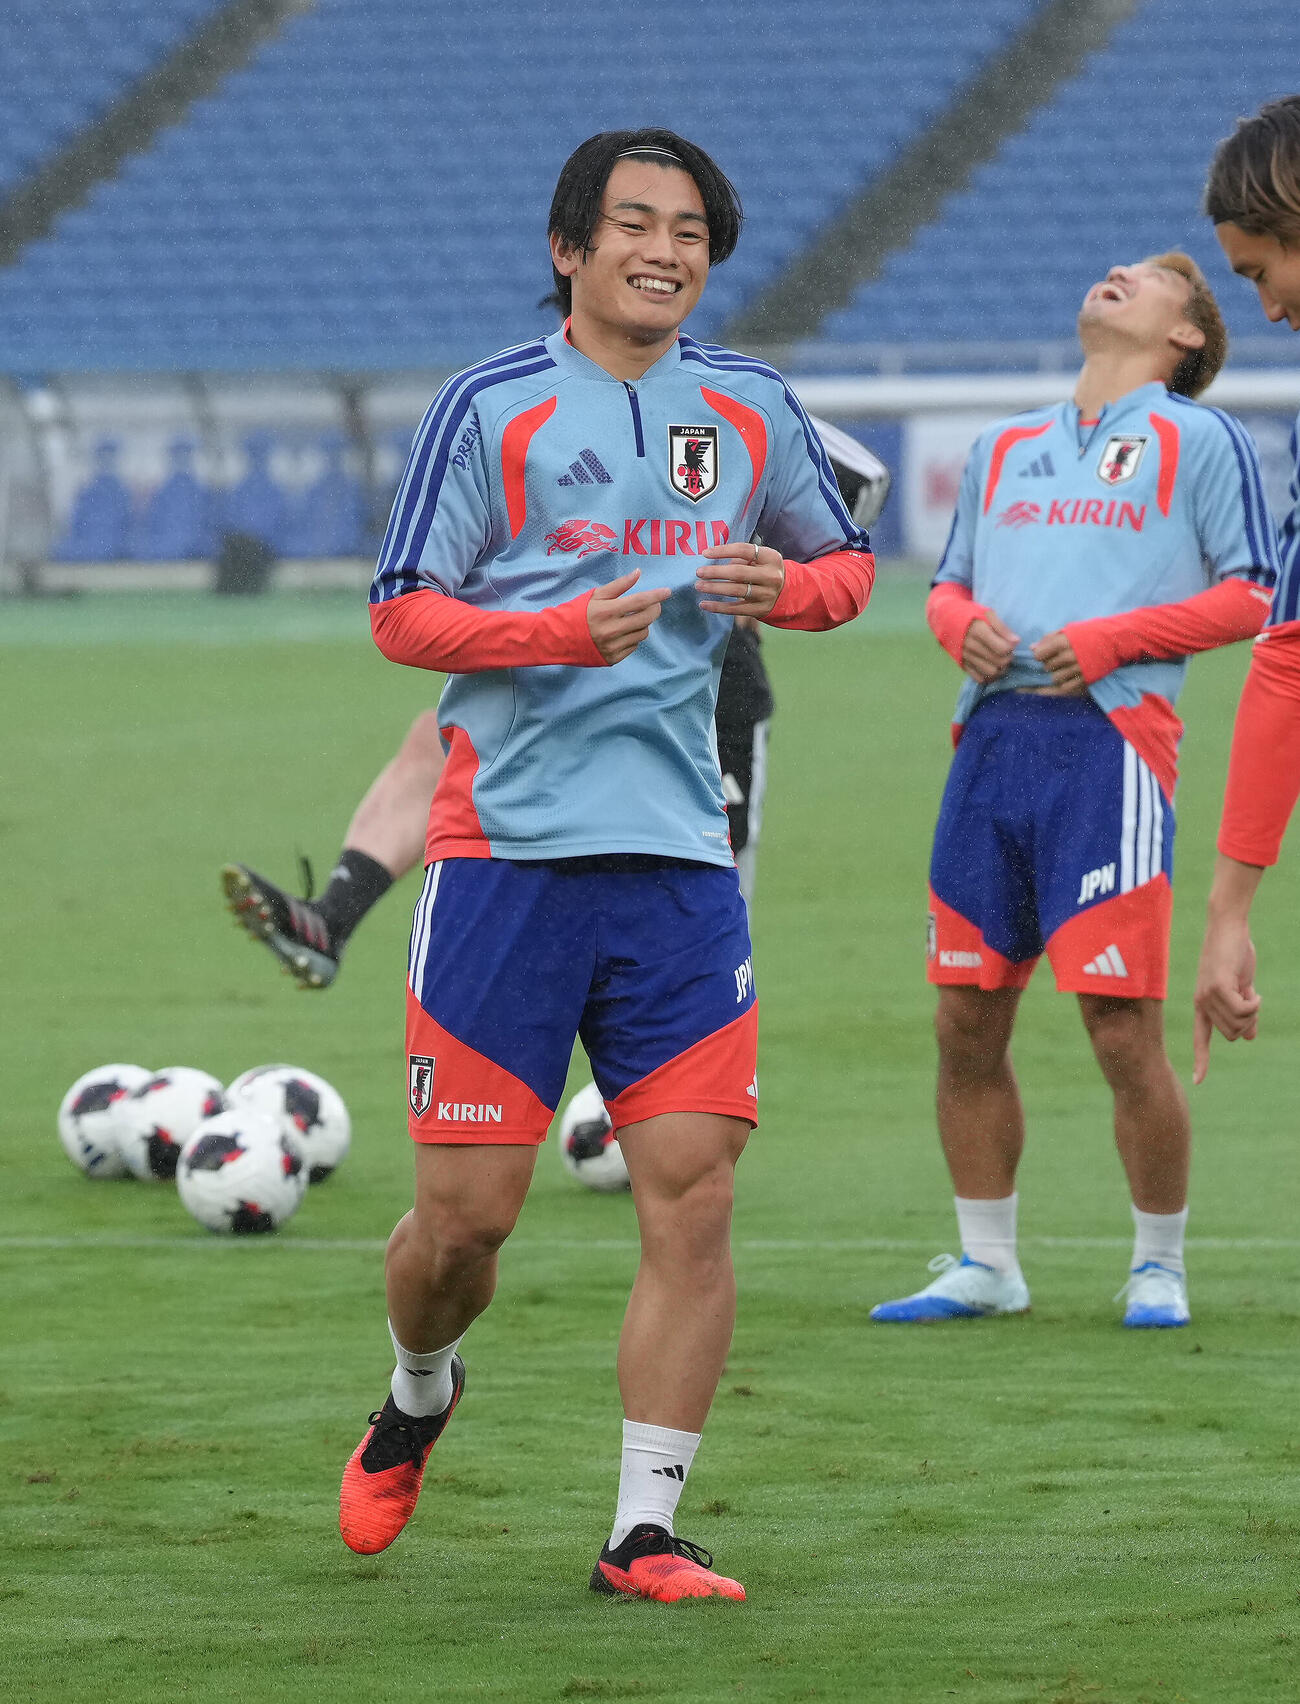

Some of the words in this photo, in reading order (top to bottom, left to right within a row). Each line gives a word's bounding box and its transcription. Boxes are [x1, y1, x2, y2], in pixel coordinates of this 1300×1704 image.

[682, 477, 705, 490] JFA
[1047, 499, 1147, 533] KIRIN
[1077, 862, 1117, 905] JPN
[437, 1102, 503, 1123] KIRIN
